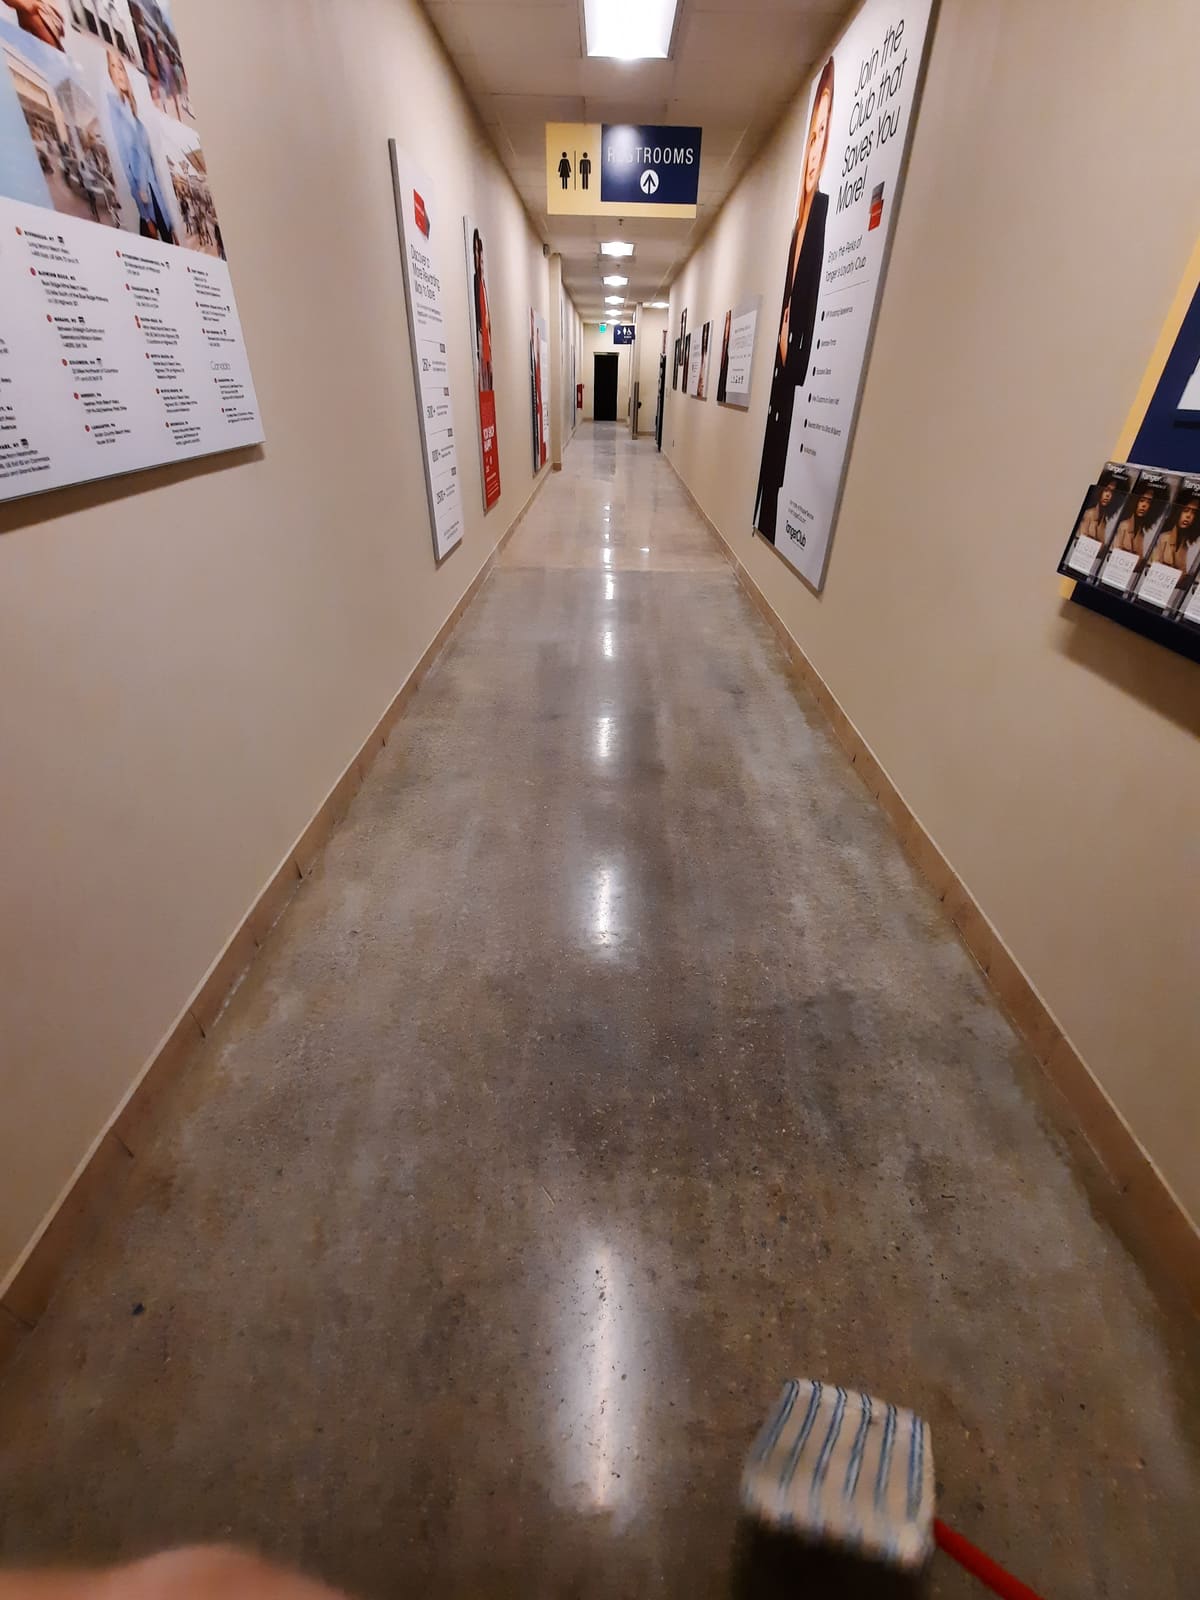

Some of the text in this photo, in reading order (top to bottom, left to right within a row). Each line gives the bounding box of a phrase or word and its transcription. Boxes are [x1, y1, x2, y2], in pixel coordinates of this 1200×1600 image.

[854, 19, 905, 97] Join the
[849, 48, 908, 137] Club that
[607, 146, 694, 165] RSTROOMS
[841, 105, 901, 178] Saves You
[835, 165, 868, 215] More!
[855, 255, 867, 271] Club
